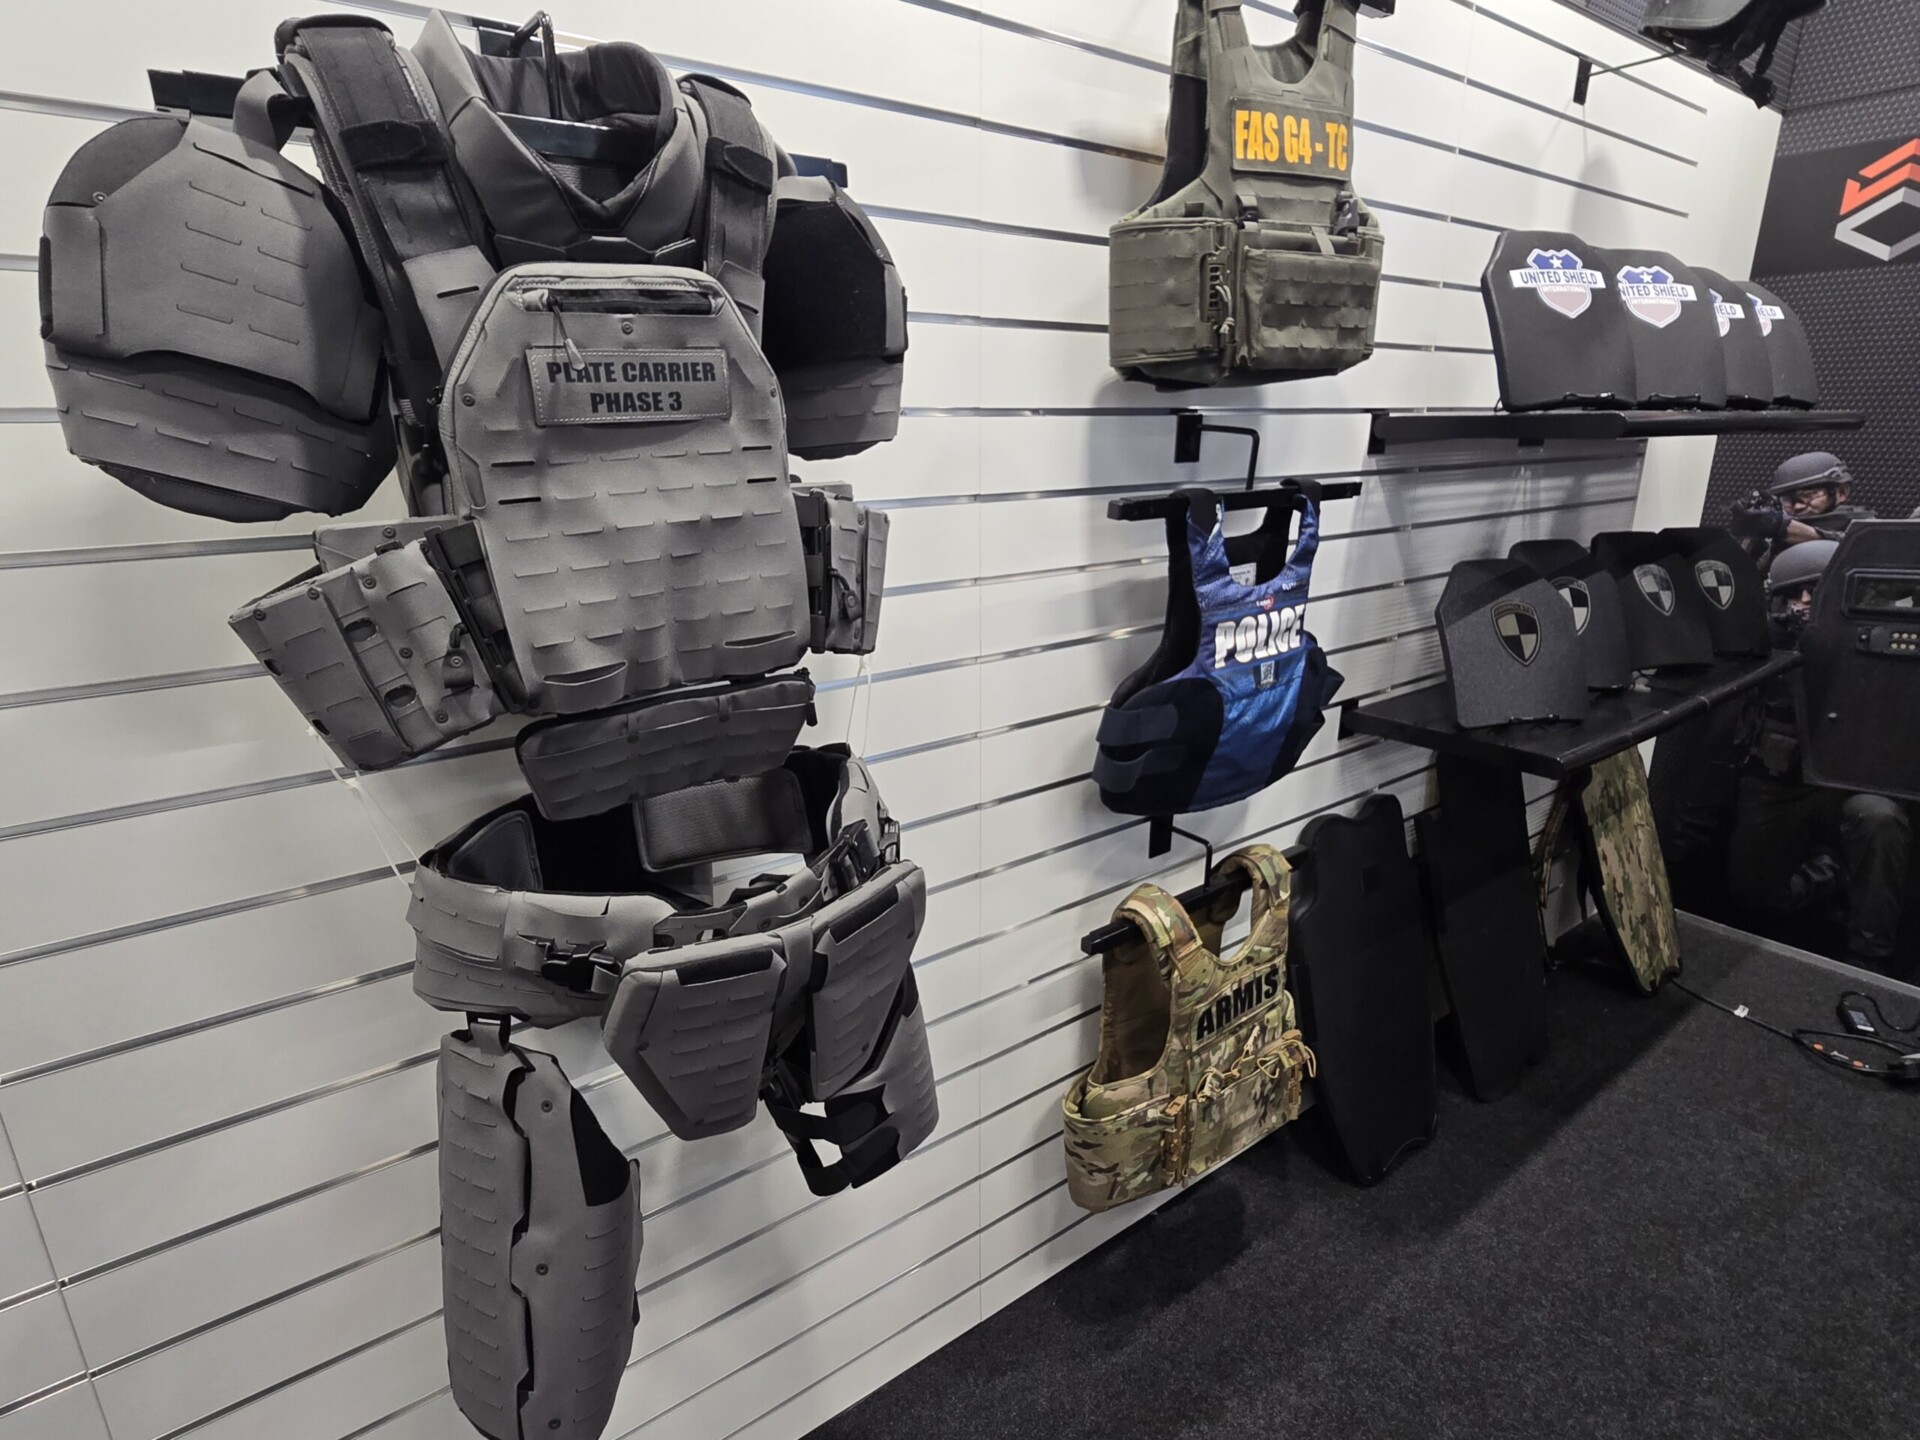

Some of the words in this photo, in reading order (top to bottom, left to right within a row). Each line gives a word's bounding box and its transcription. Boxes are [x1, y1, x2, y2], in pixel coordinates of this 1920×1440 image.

[1235, 109, 1279, 162] FAS
[1283, 115, 1312, 164] G4
[1326, 122, 1348, 171] TC
[1520, 271, 1561, 284] UNITED
[1563, 271, 1598, 285] SHIELD
[1620, 285, 1651, 297] NITED
[1653, 285, 1689, 297] SHIELD
[1715, 304, 1737, 315] IELD
[1757, 307, 1777, 317] IELD
[546, 361, 617, 383] PLATE
[621, 361, 717, 383] CARRIER
[590, 392, 663, 414] PHASE
[668, 391, 683, 412] 3
[1214, 603, 1306, 669] POLICE
[1196, 967, 1279, 1041] ARMIS
